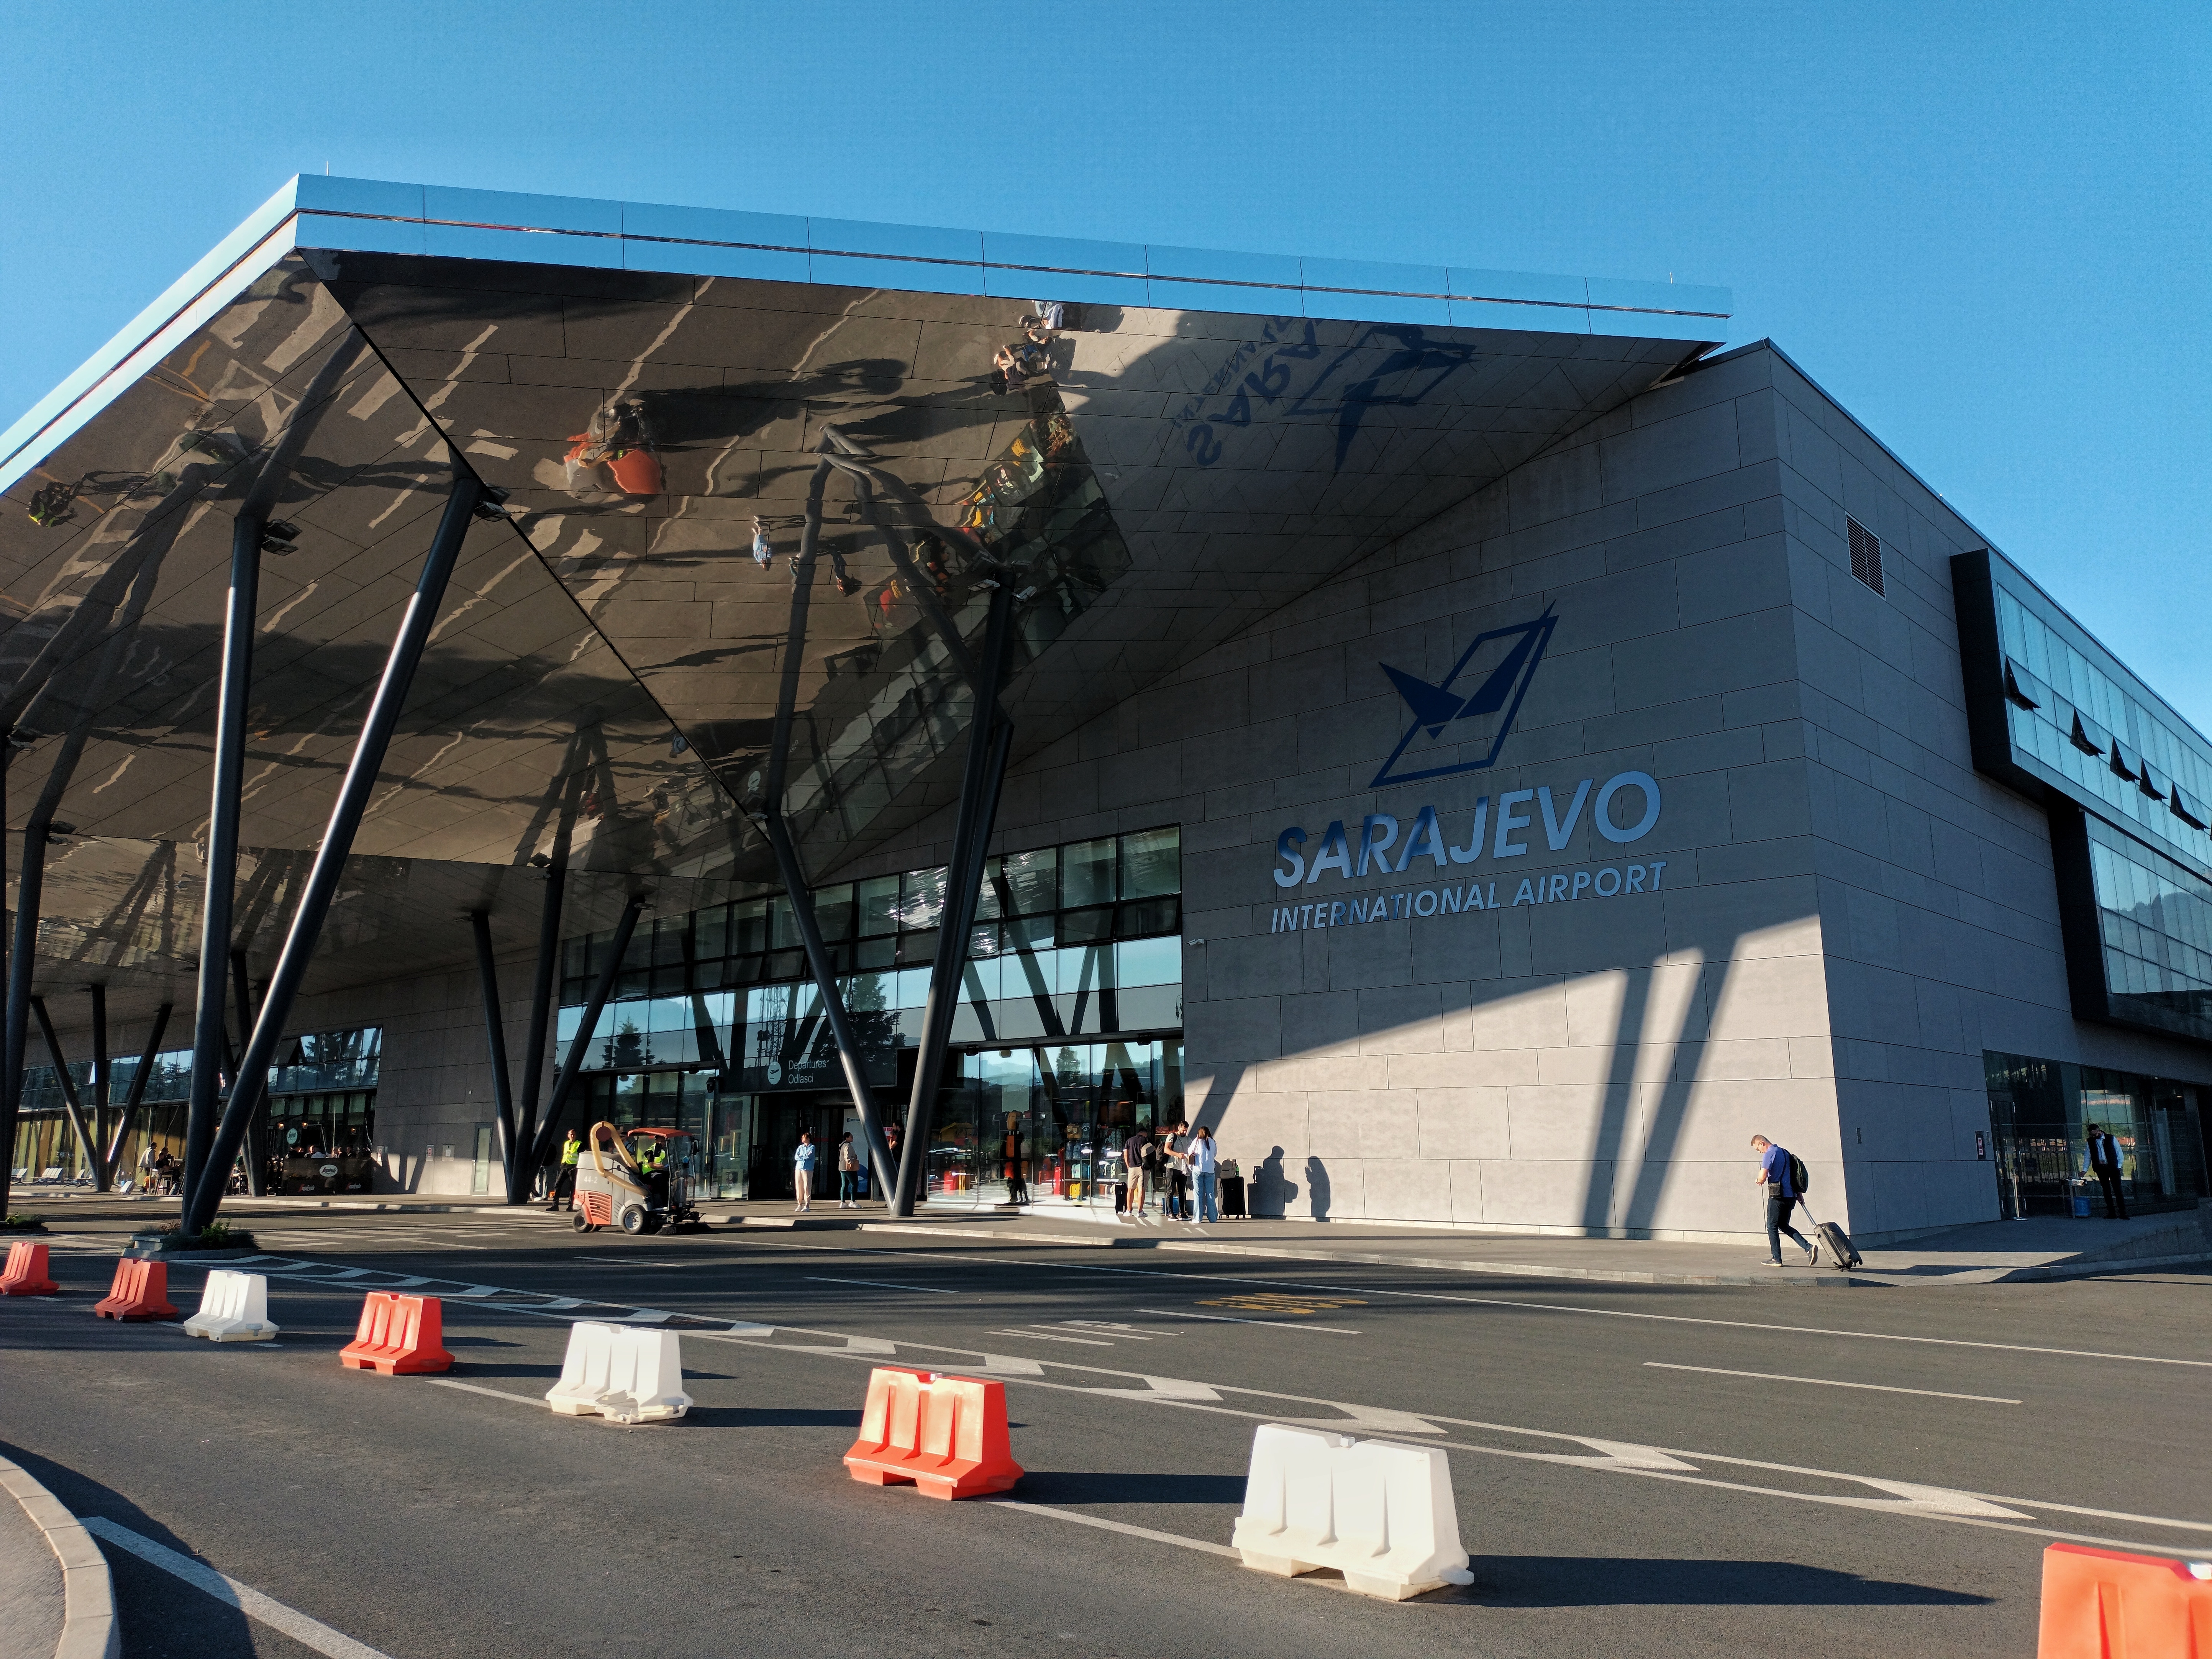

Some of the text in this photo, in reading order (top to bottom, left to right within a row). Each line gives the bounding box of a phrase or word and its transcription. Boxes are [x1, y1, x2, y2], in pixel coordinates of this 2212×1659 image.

[1273, 770, 1661, 888] SARAJEVO
[1271, 861, 1668, 933] INTERNATIONAL AIRPORT
[789, 1059, 826, 1071] Departures
[788, 1073, 813, 1084] Odlasci
[584, 1175, 598, 1184] 44-2
[1191, 1292, 1369, 1314] BUS
[984, 1320, 1180, 1346] VIP
